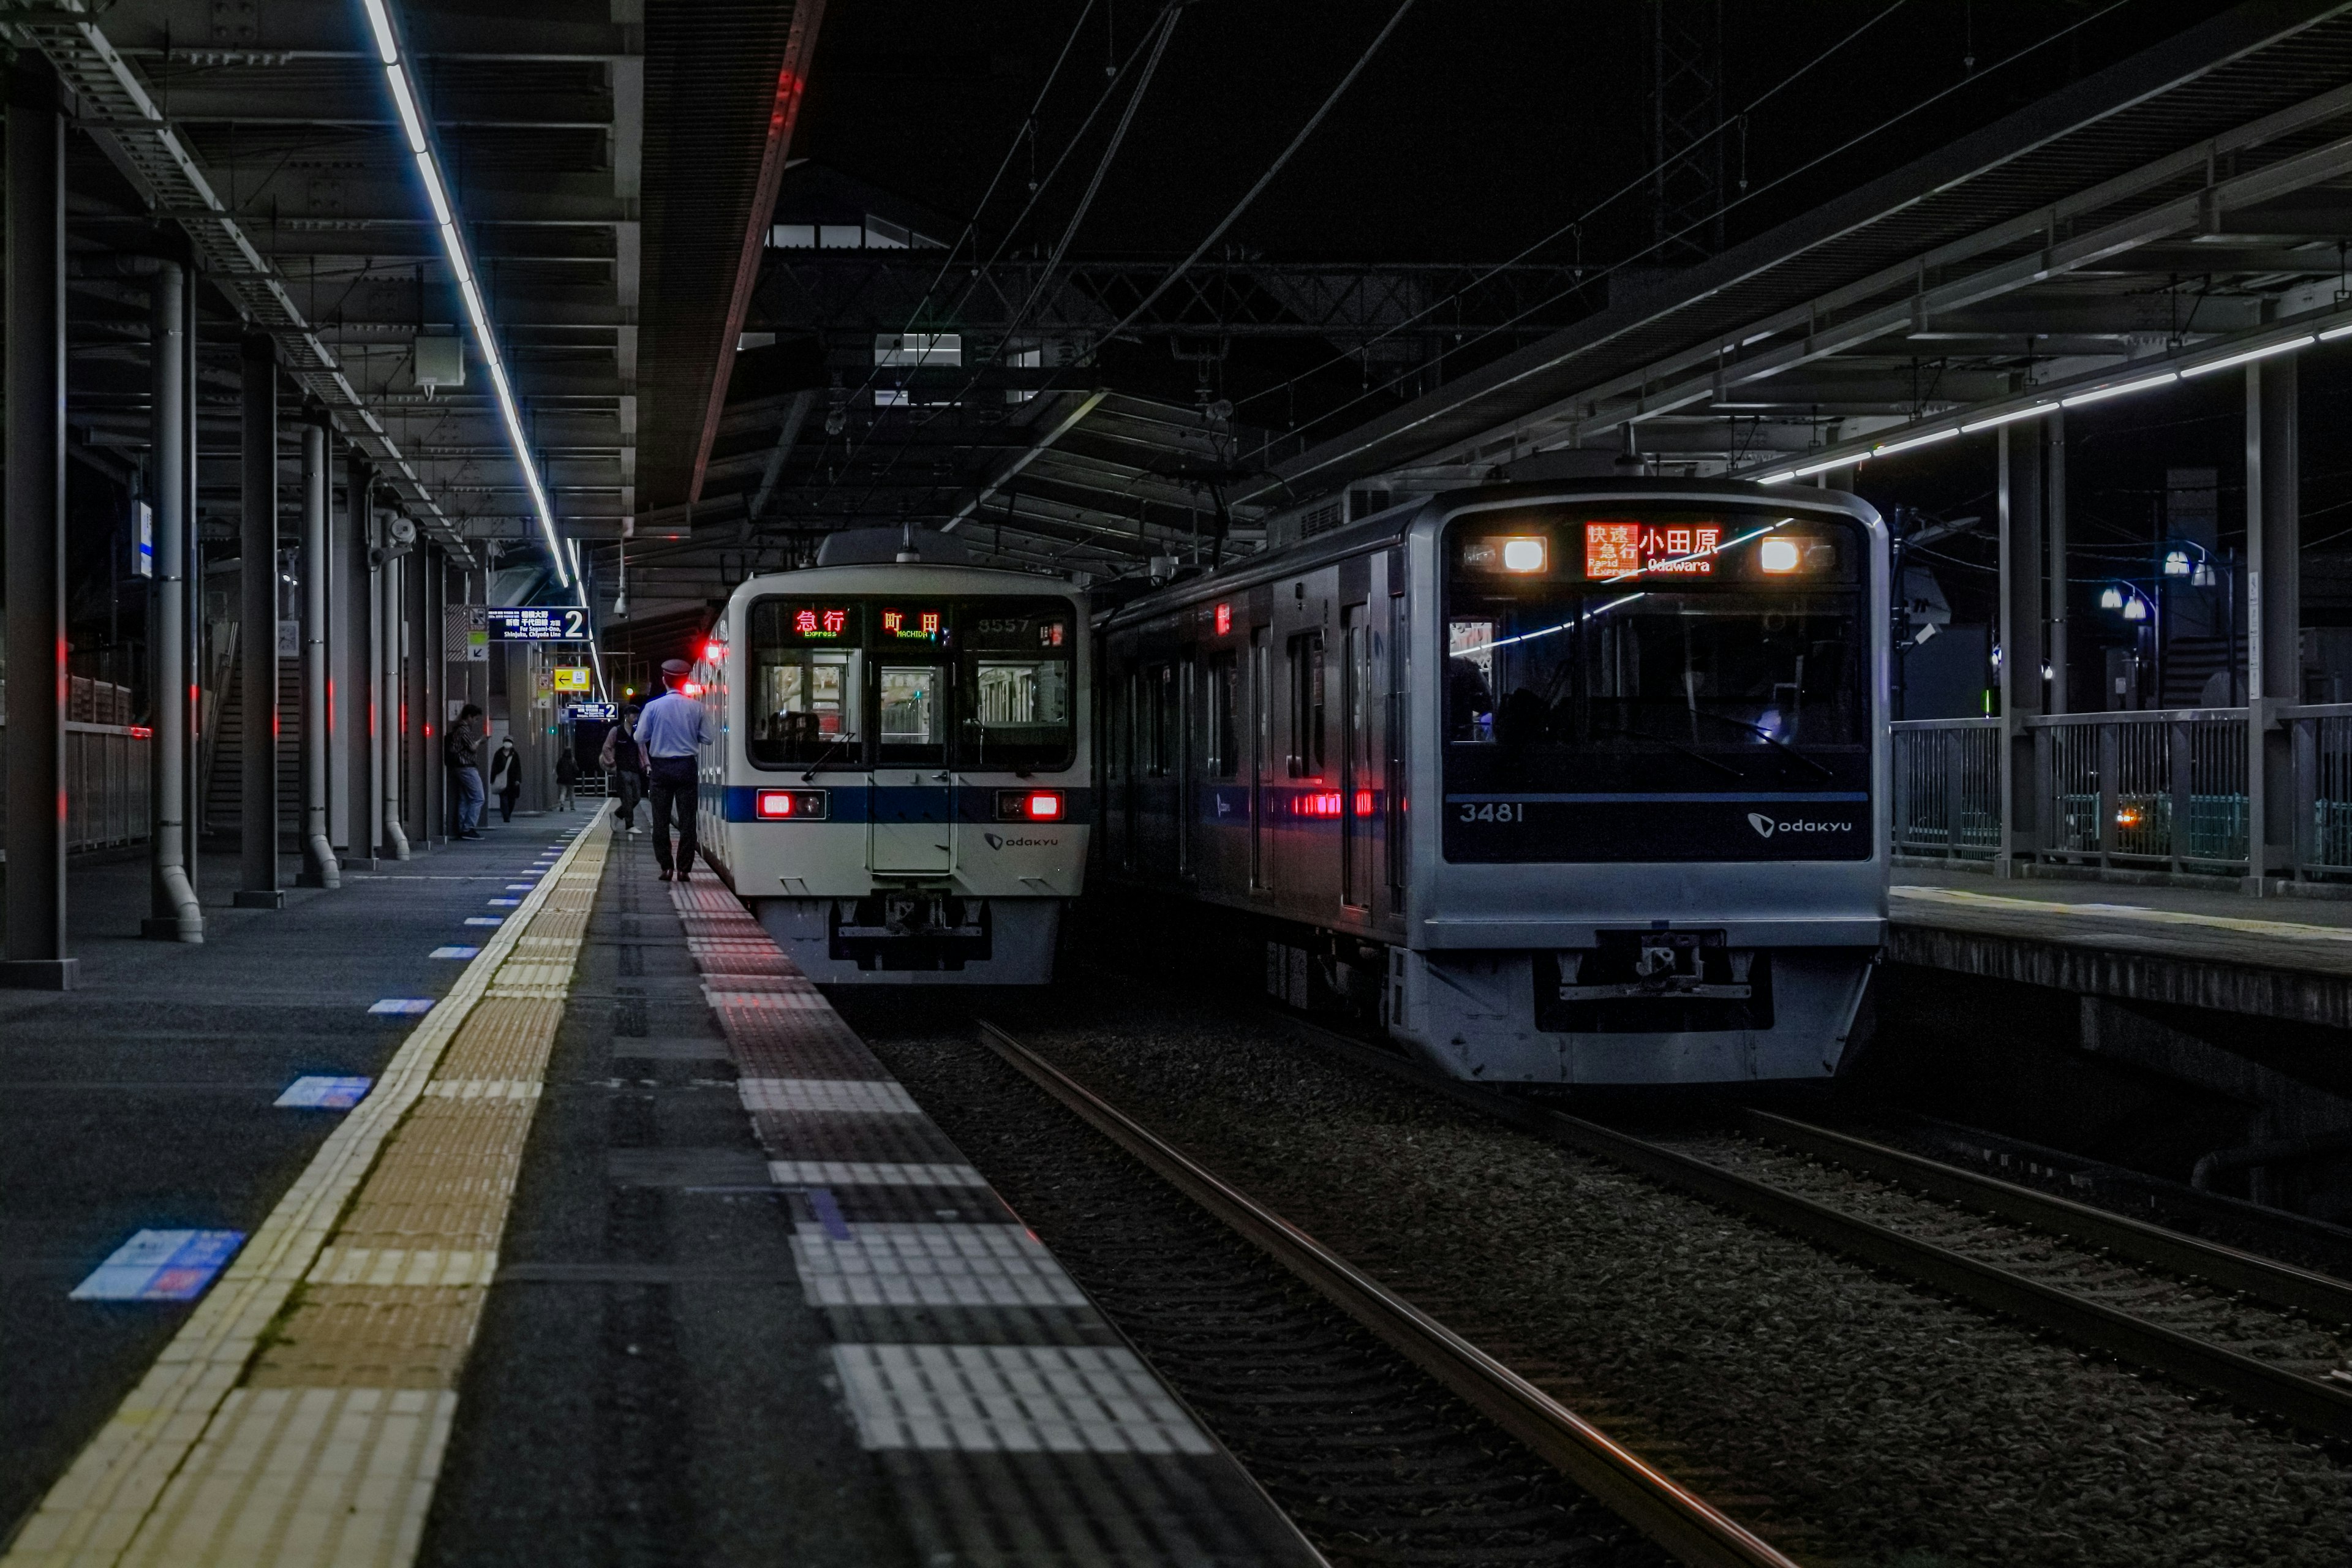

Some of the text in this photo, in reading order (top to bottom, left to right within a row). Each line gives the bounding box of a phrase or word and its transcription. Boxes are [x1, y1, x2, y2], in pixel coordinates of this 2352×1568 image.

[1589, 526, 1628, 543] 快速
[1638, 529, 1719, 555] 小田原
[1600, 543, 1637, 559] 急行
[1588, 558, 1618, 567] Rapid
[1648, 558, 1710, 572] Odawara
[565, 610, 583, 638] 2
[796, 611, 844, 631] 急行
[605, 704, 616, 718] 2
[1460, 803, 1523, 822] 3481
[1778, 819, 1852, 832] odakyu
[1006, 837, 1058, 846] odakyu
